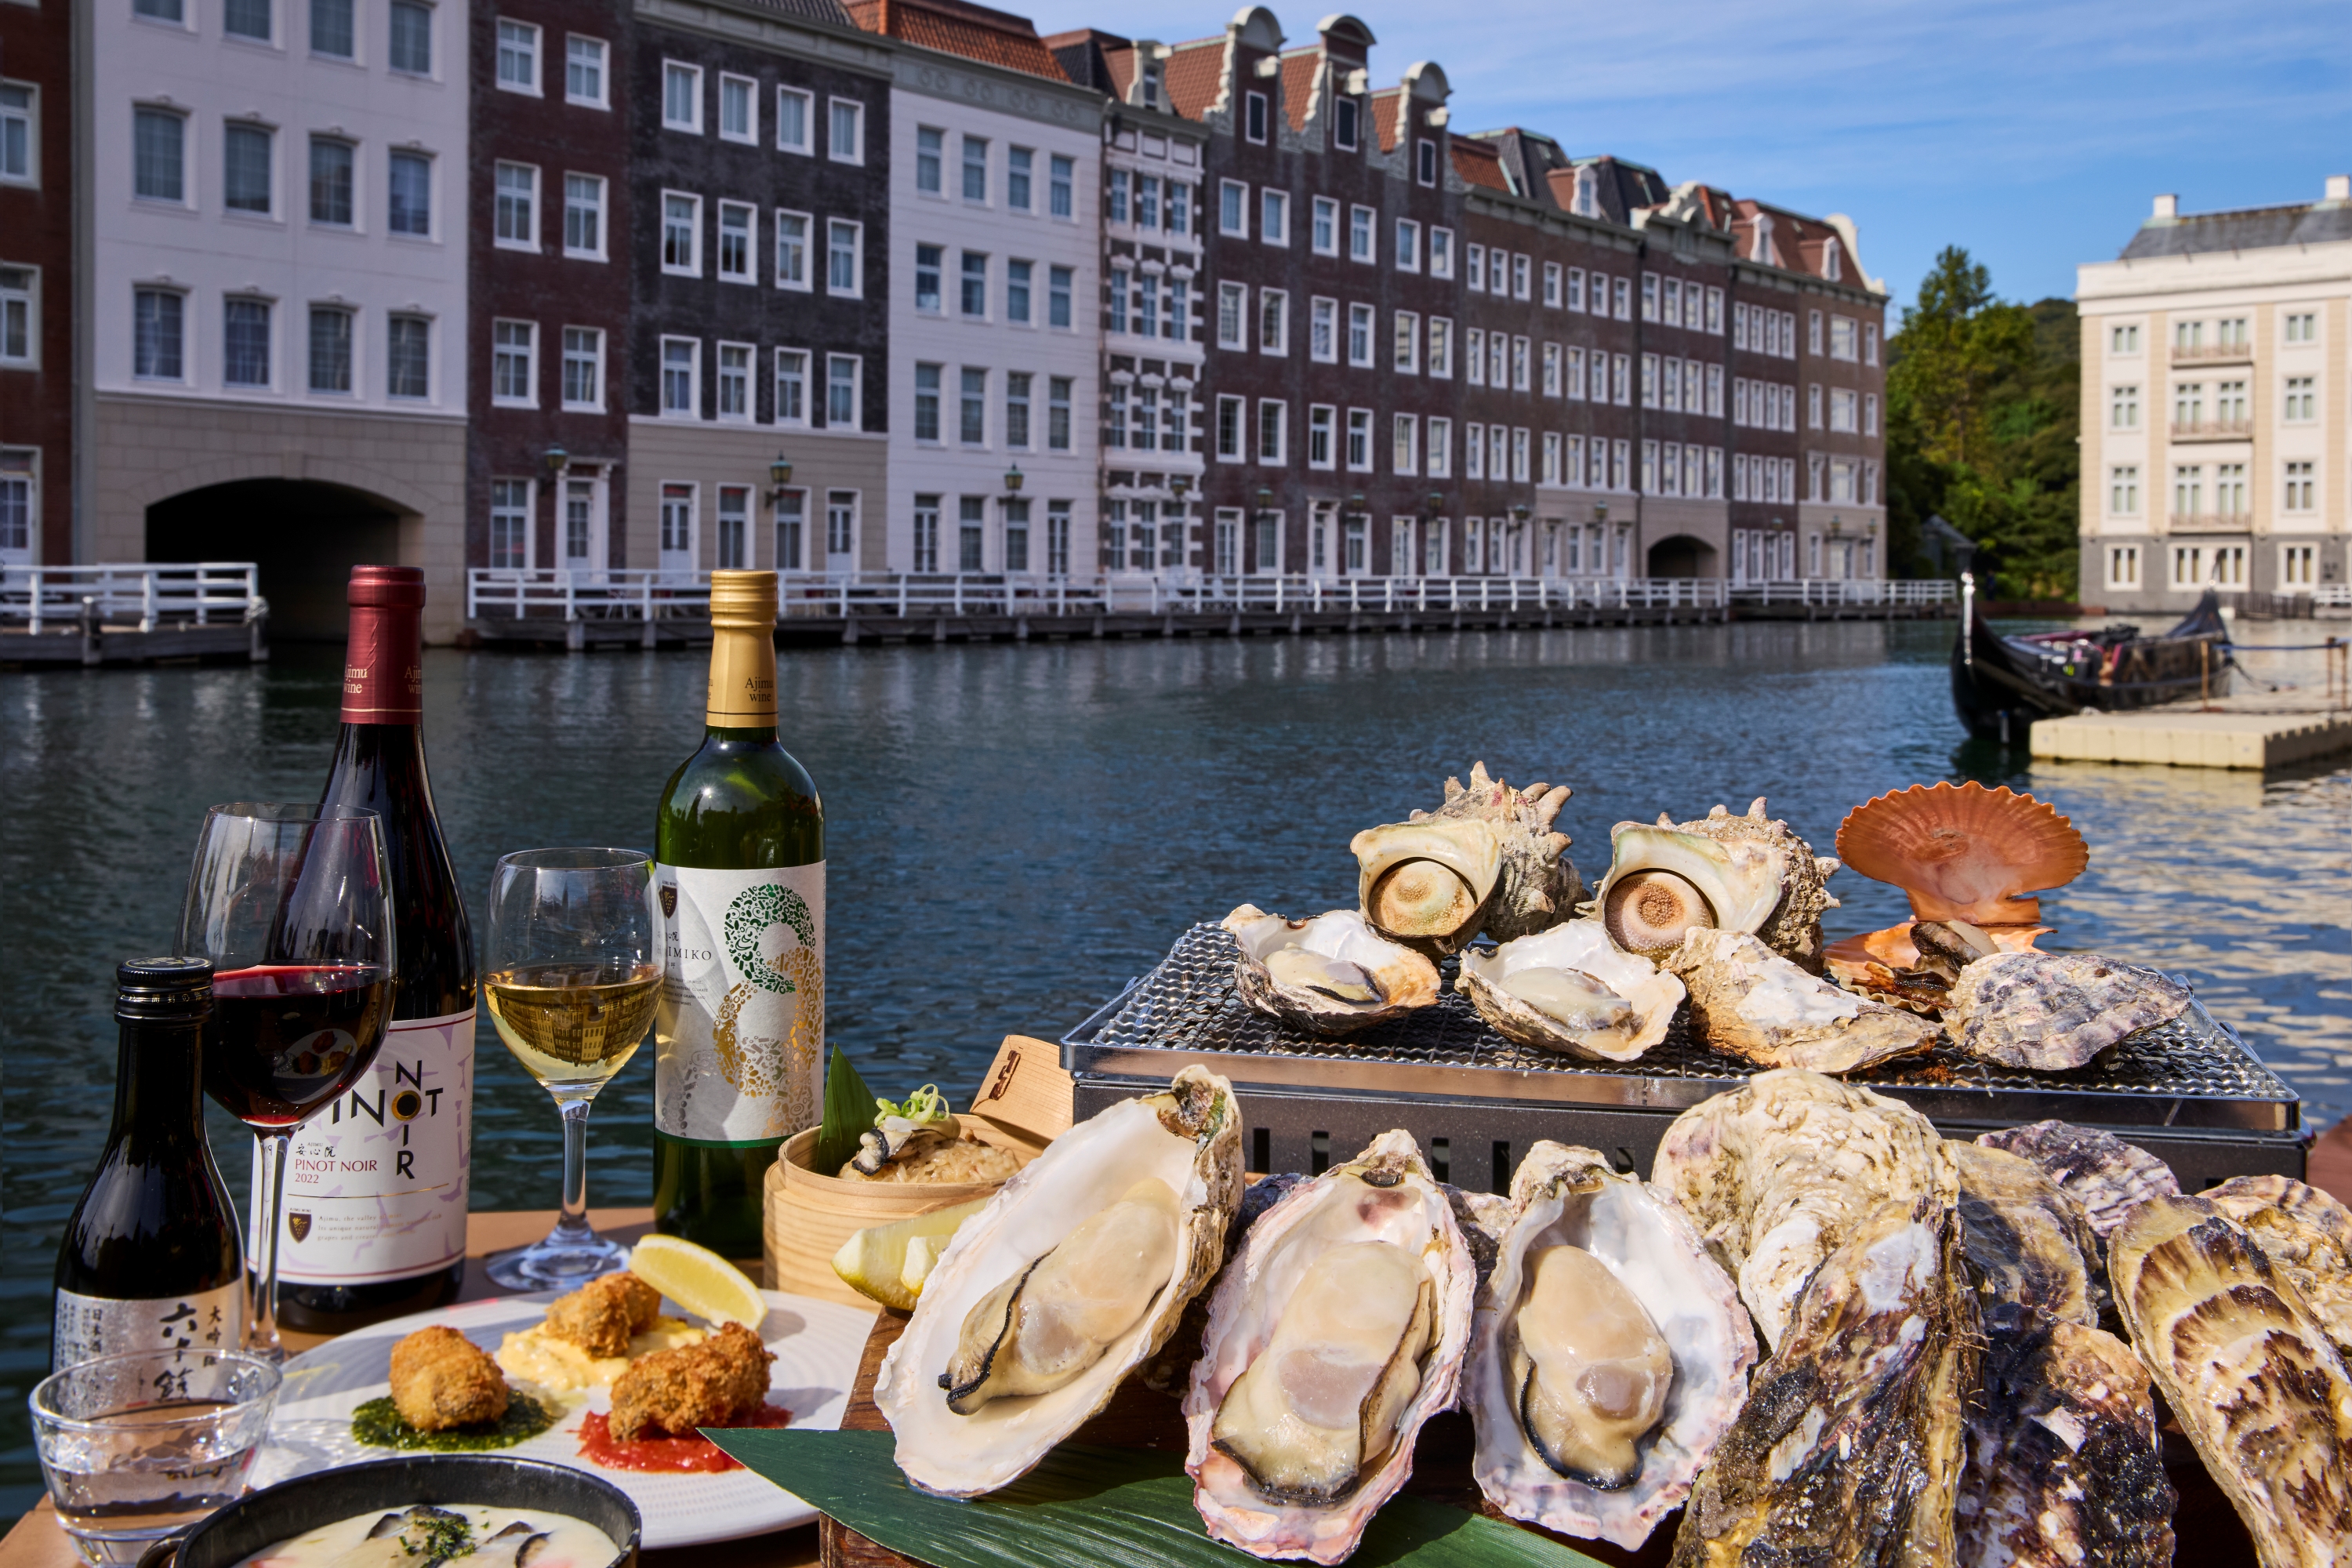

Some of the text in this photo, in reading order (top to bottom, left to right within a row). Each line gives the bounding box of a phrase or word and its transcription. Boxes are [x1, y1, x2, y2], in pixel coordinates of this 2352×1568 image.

[745, 677, 773, 691] Ajimu
[750, 690, 771, 702] wine
[298, 1087, 444, 1132] INOT
[295, 1159, 378, 1172] PINOT NOIR
[295, 1173, 319, 1184] 2022
